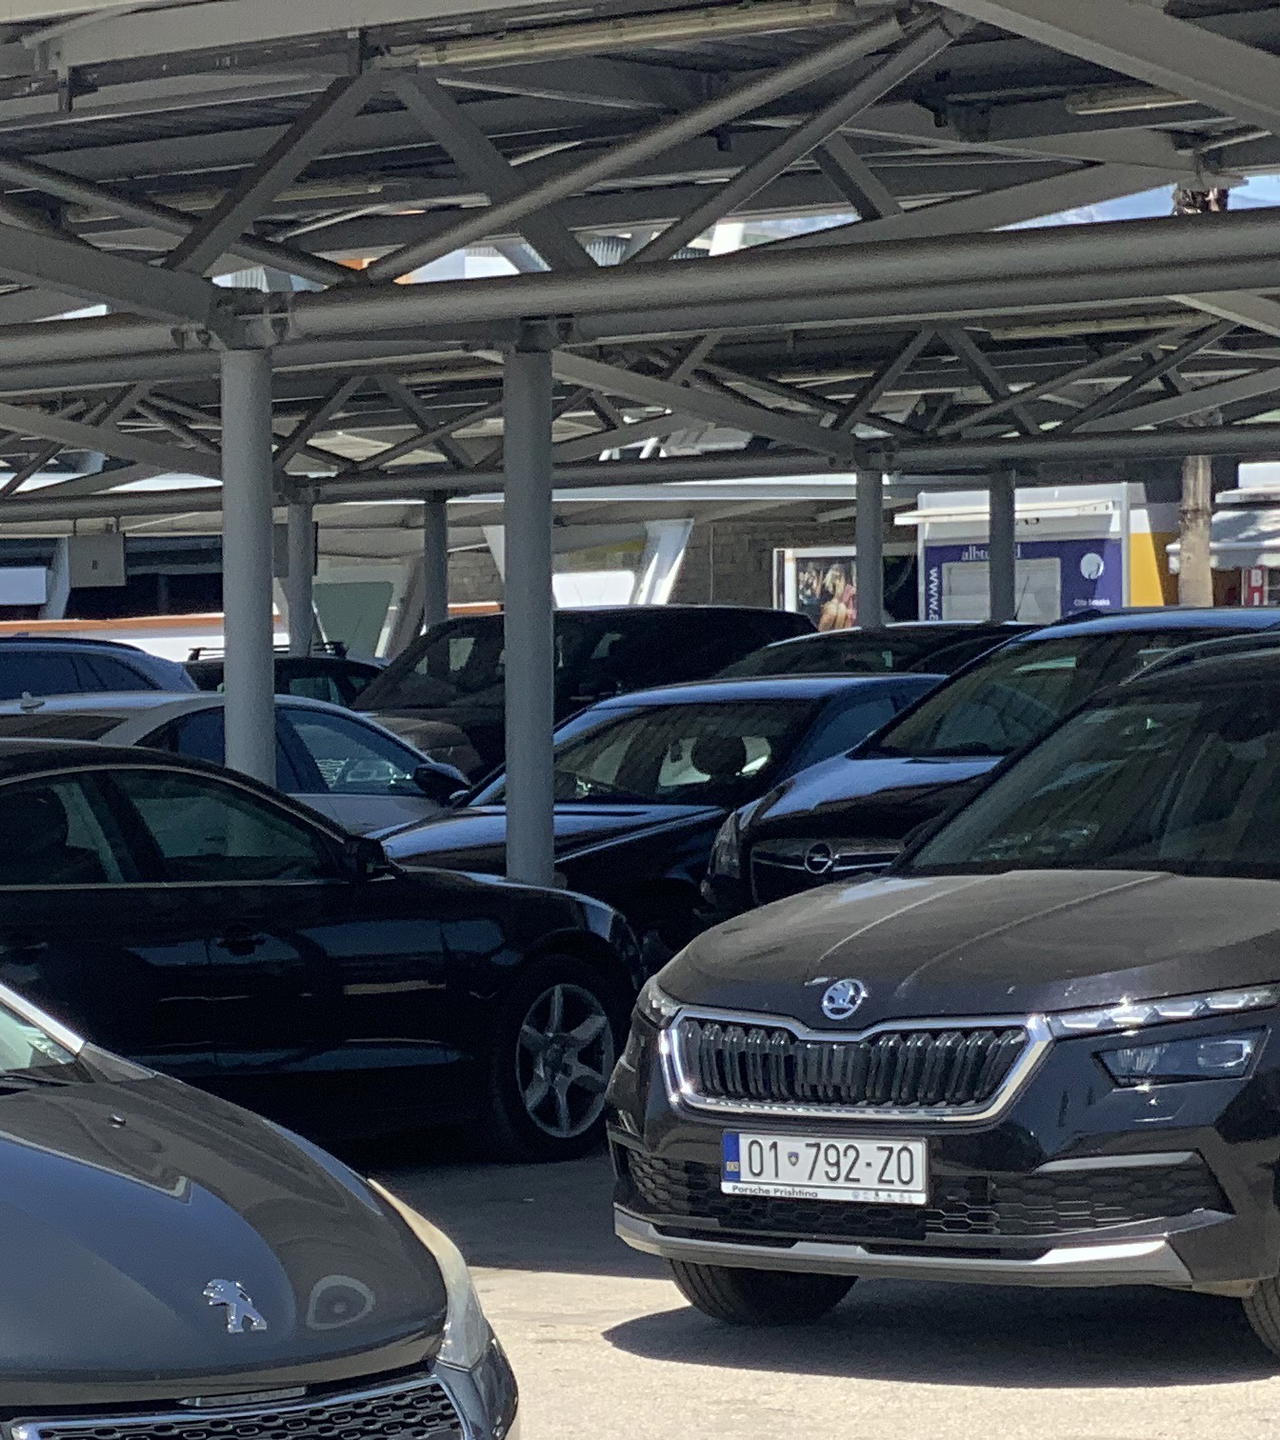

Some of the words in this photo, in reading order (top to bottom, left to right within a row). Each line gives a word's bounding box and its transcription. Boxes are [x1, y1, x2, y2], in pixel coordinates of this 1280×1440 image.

[747, 1139, 780, 1179] 01
[732, 1184, 771, 1196] Porsche
[773, 1187, 819, 1199] Prishtina
